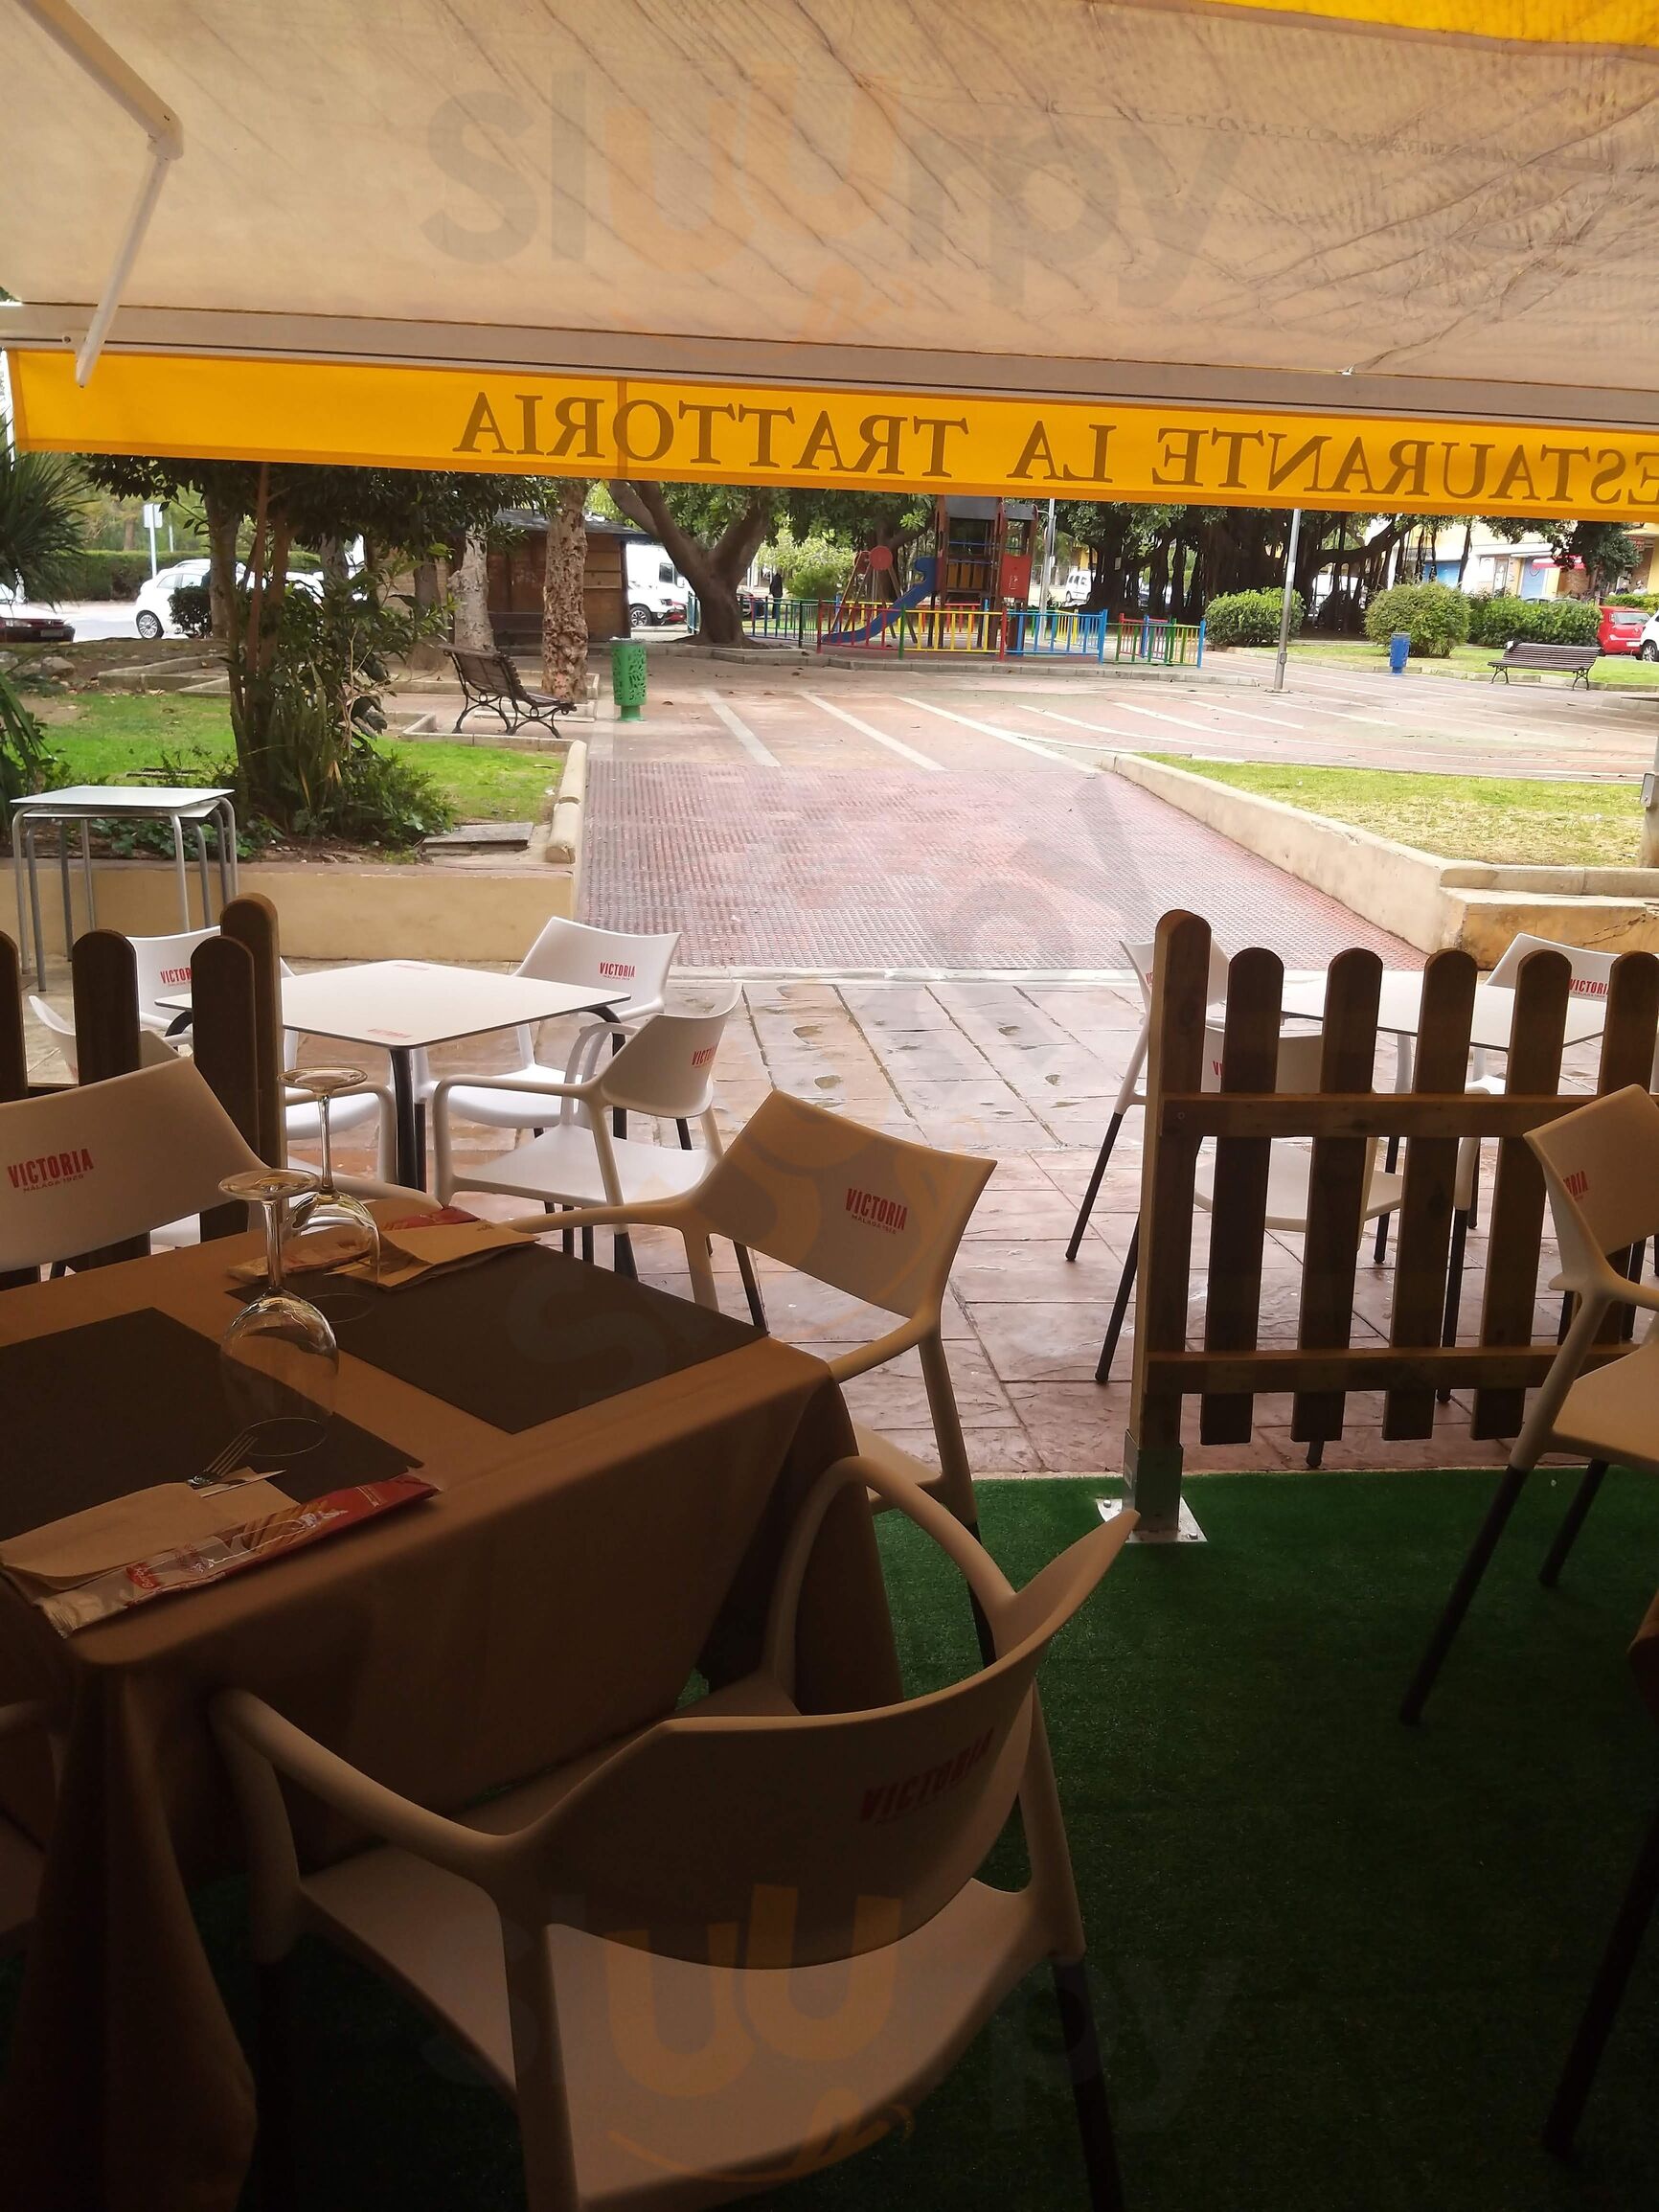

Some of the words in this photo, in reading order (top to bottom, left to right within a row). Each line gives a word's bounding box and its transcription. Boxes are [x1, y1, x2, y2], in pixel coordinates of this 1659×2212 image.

[160, 967, 193, 984] VICTOR
[600, 962, 636, 978] VICTORIA
[1569, 978, 1609, 995] VICTORI
[8, 1148, 94, 1189] VICTORIA
[846, 1188, 908, 1231] VICTORIA
[860, 1725, 994, 1824] VICTORIA
